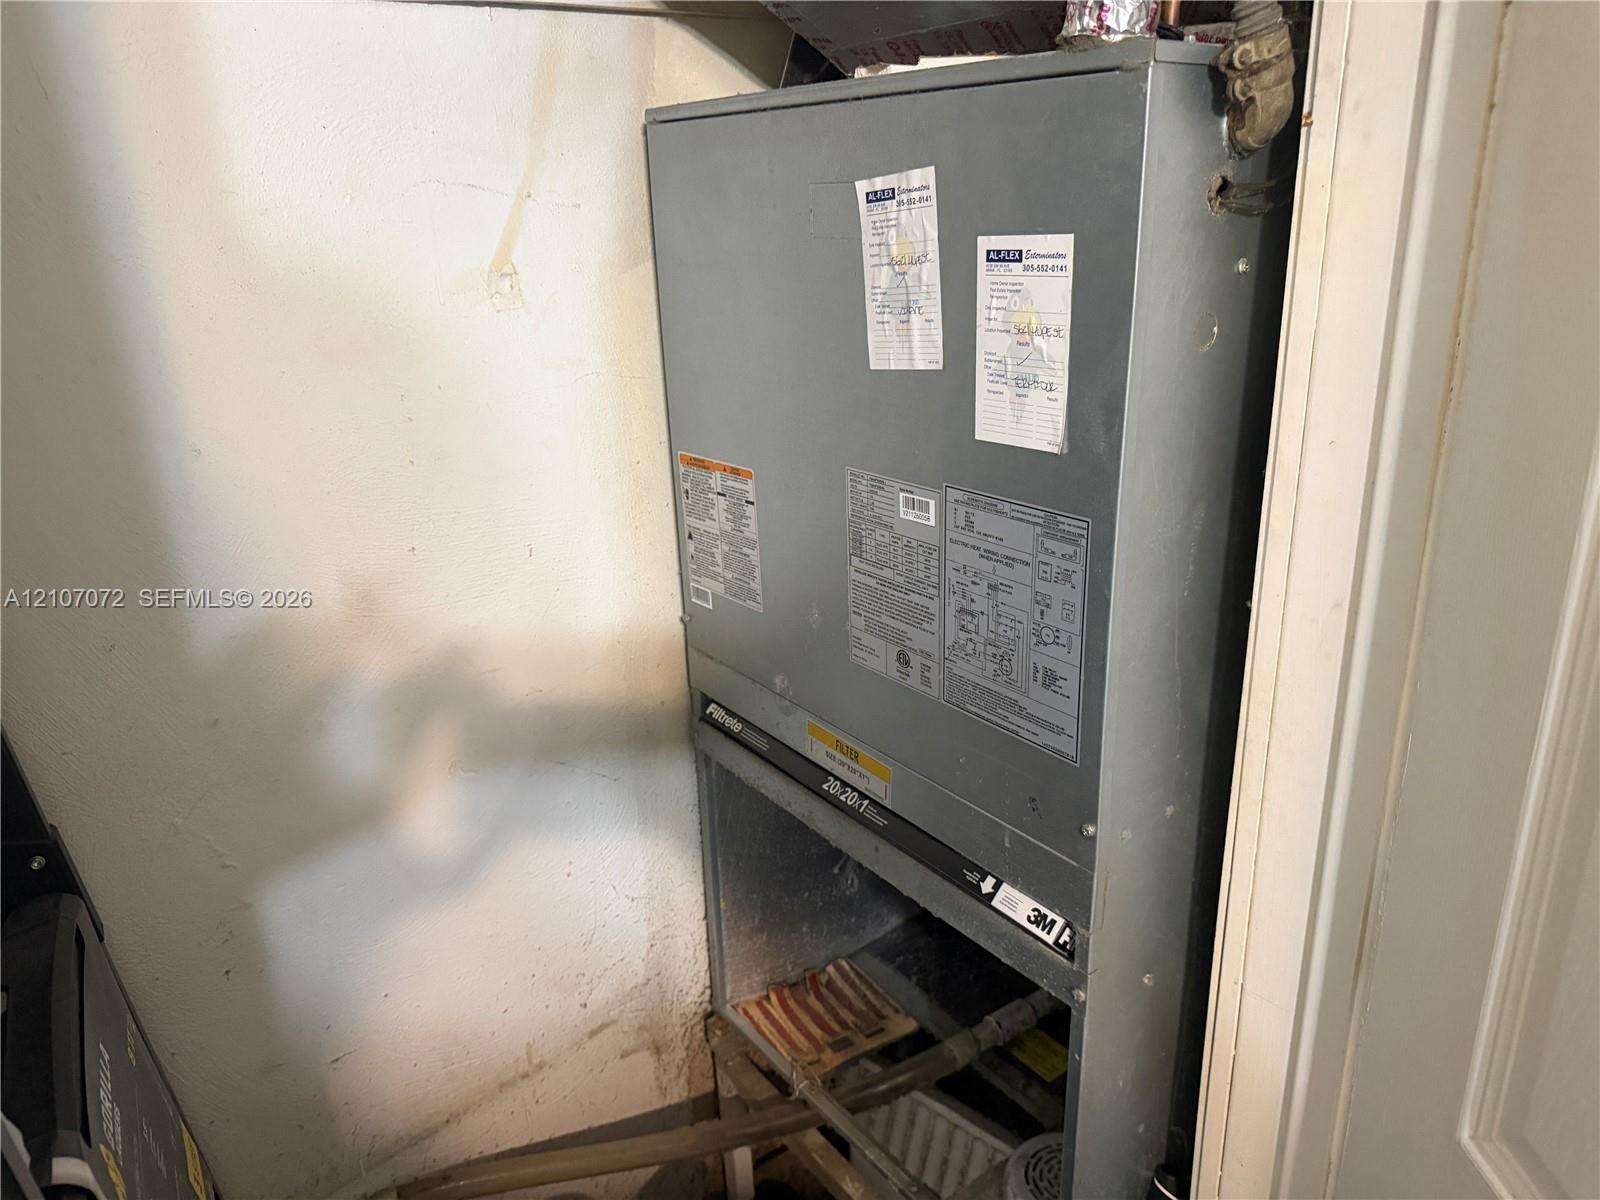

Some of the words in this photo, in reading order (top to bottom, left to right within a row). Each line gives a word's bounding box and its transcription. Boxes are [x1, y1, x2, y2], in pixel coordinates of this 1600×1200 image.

[868, 189, 893, 201] AL-FLEX
[896, 184, 930, 196] Exterminators
[896, 195, 932, 207] 305-552-0141
[988, 251, 1020, 260] AL-FLEX
[1024, 249, 1067, 260] Exterminators
[1022, 264, 1068, 273] 305-552-0141
[1000, 552, 1031, 567] CONNECTION
[705, 702, 743, 734] Filtrete
[835, 739, 860, 764] FILTER
[821, 776, 870, 813] 20x20x1
[1026, 907, 1058, 936] 3M
[99, 1042, 116, 1151] GORILLA
